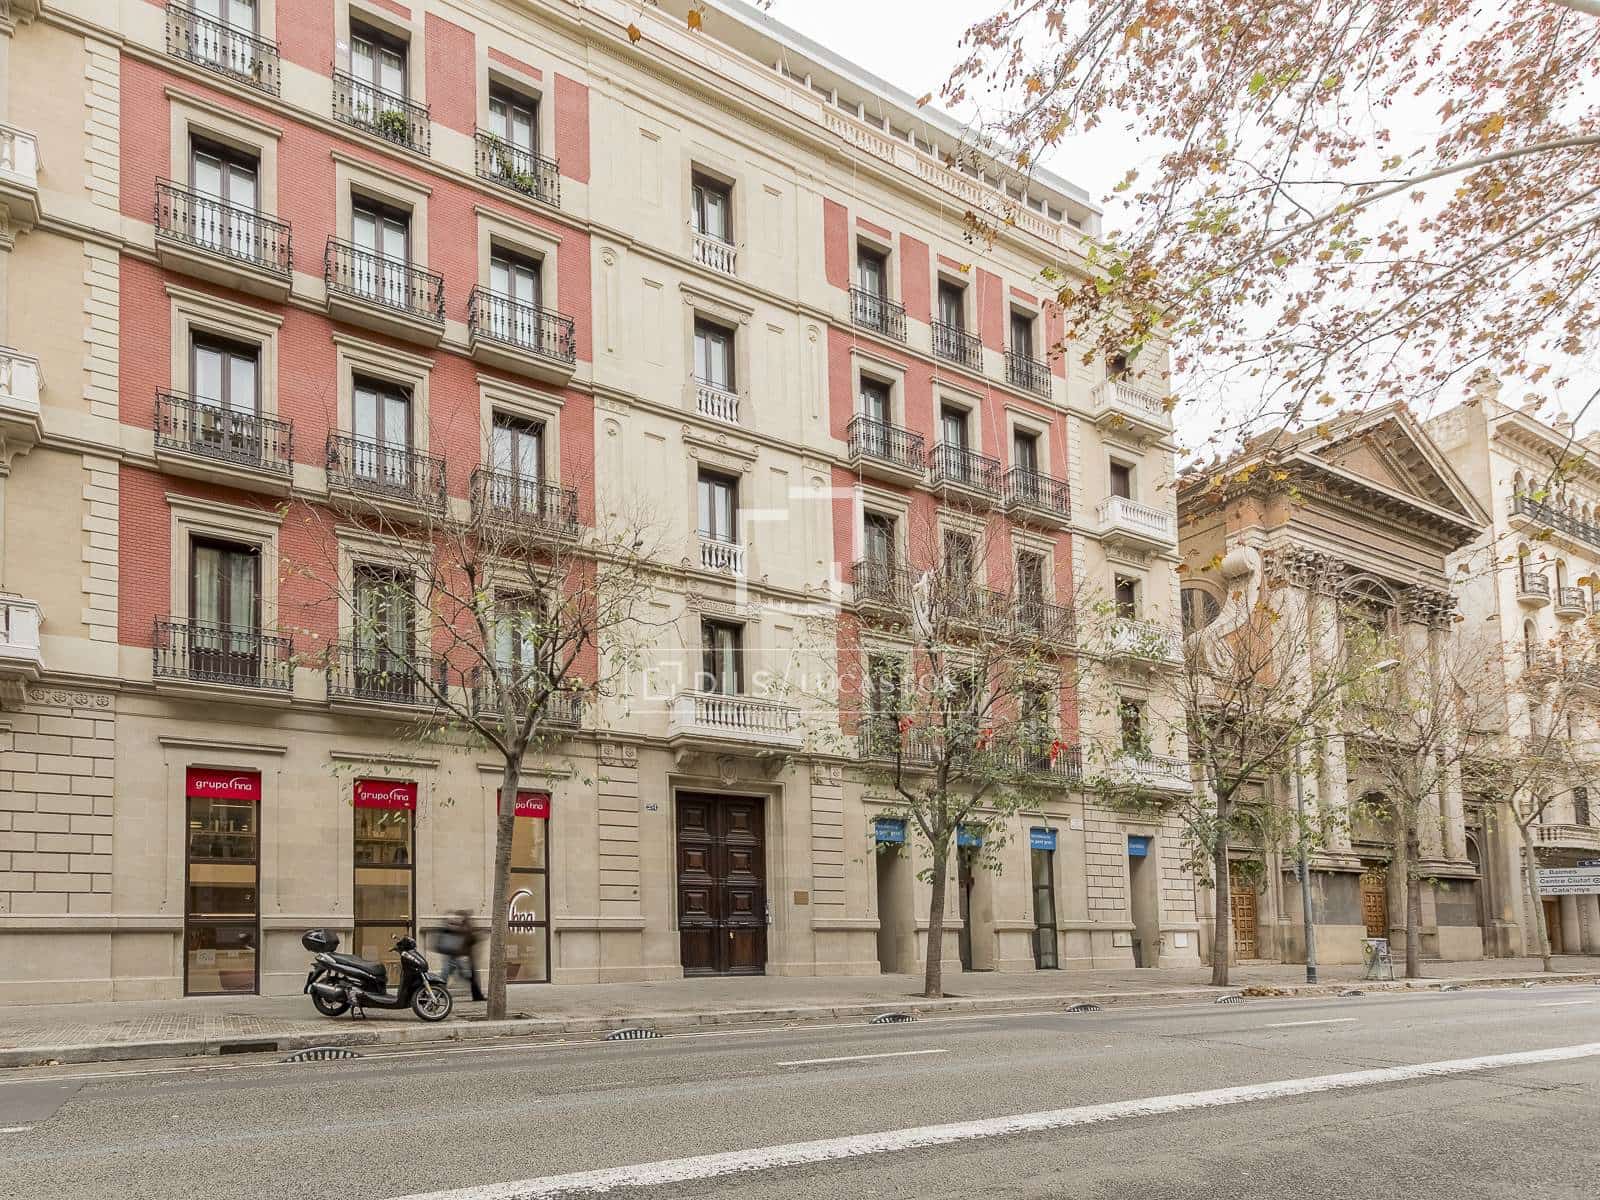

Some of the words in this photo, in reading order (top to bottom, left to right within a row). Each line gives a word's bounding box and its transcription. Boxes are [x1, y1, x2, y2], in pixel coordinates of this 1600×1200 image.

[195, 780, 229, 790] grupo
[231, 778, 252, 791] hna
[361, 792, 389, 800] grupo
